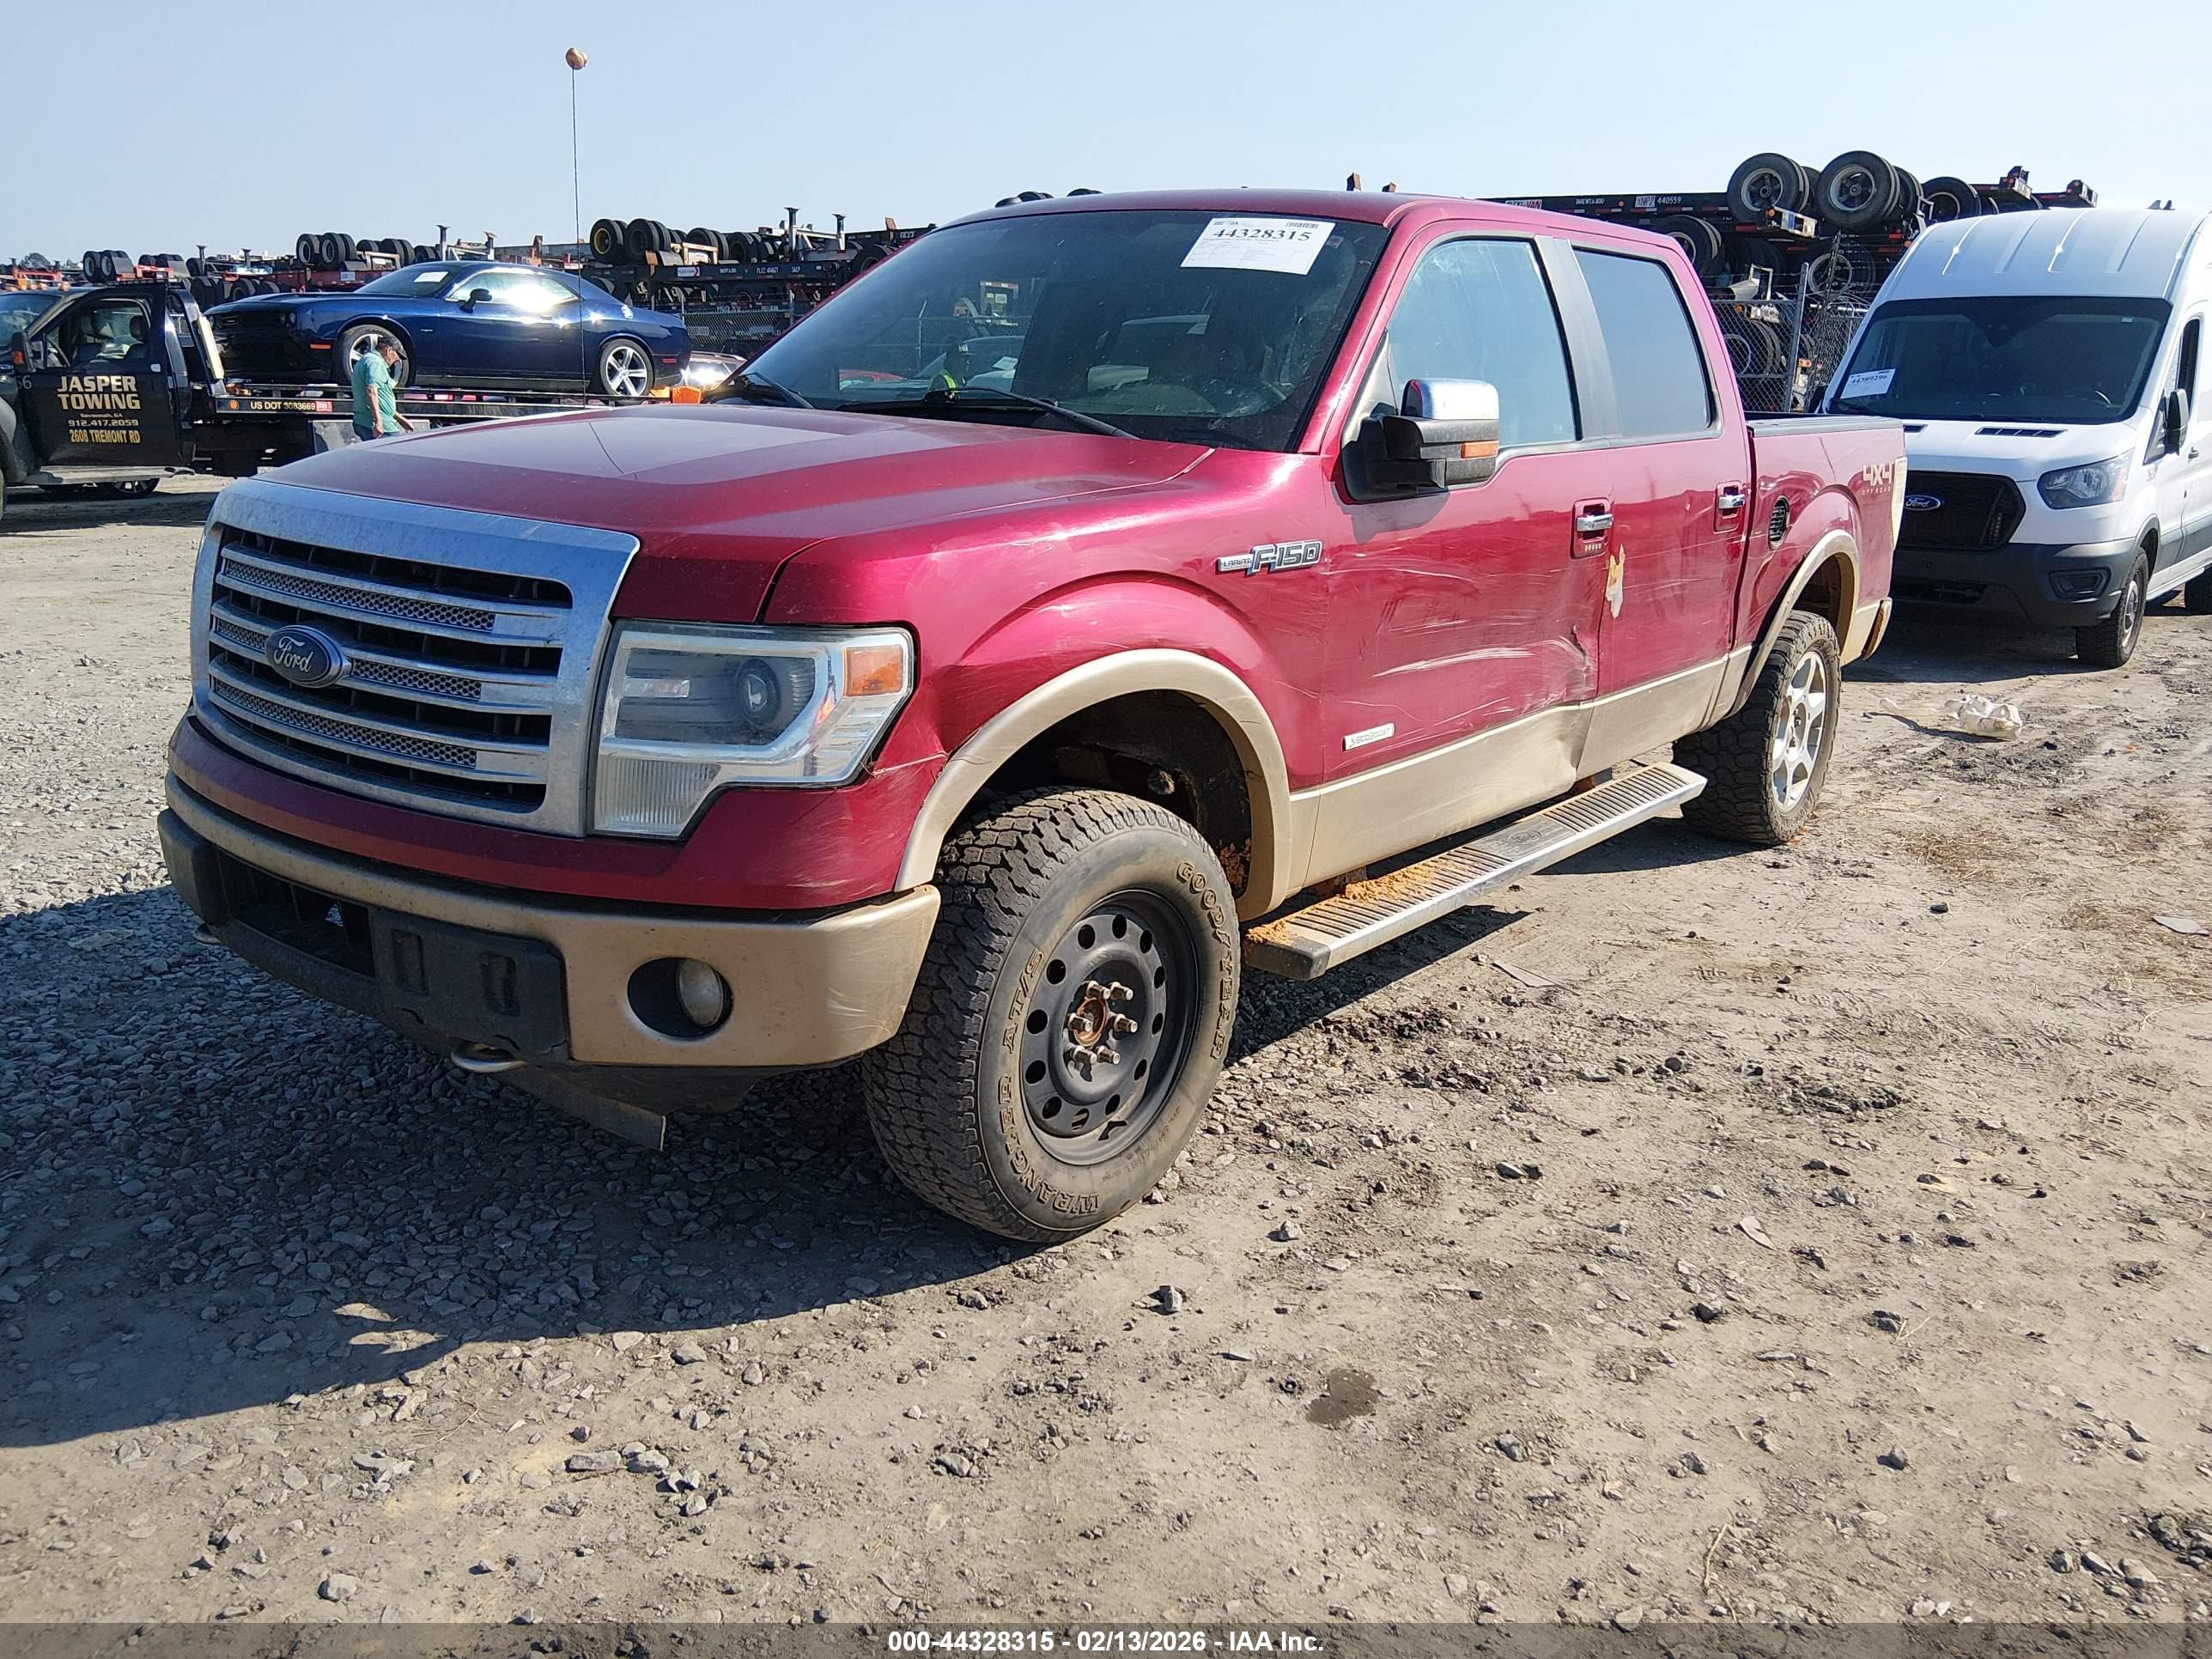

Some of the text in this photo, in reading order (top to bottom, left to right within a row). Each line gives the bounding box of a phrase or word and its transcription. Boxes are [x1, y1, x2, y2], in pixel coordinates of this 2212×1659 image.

[1212, 228, 1312, 241] 44328315
[57, 375, 137, 392] JASPER
[57, 393, 141, 410] TOWING
[251, 401, 263, 410] US
[264, 401, 282, 410] DOT
[68, 419, 139, 428] 912.417.2059
[69, 428, 141, 444] 2608 TREMONT RD
[1863, 464, 1893, 486] 4X4
[1905, 496, 1930, 508] Ford
[274, 636, 313, 672] Ford
[1176, 860, 1233, 1060] GOODYEAR
[997, 947, 1101, 1216] WRANGLER AT/S
